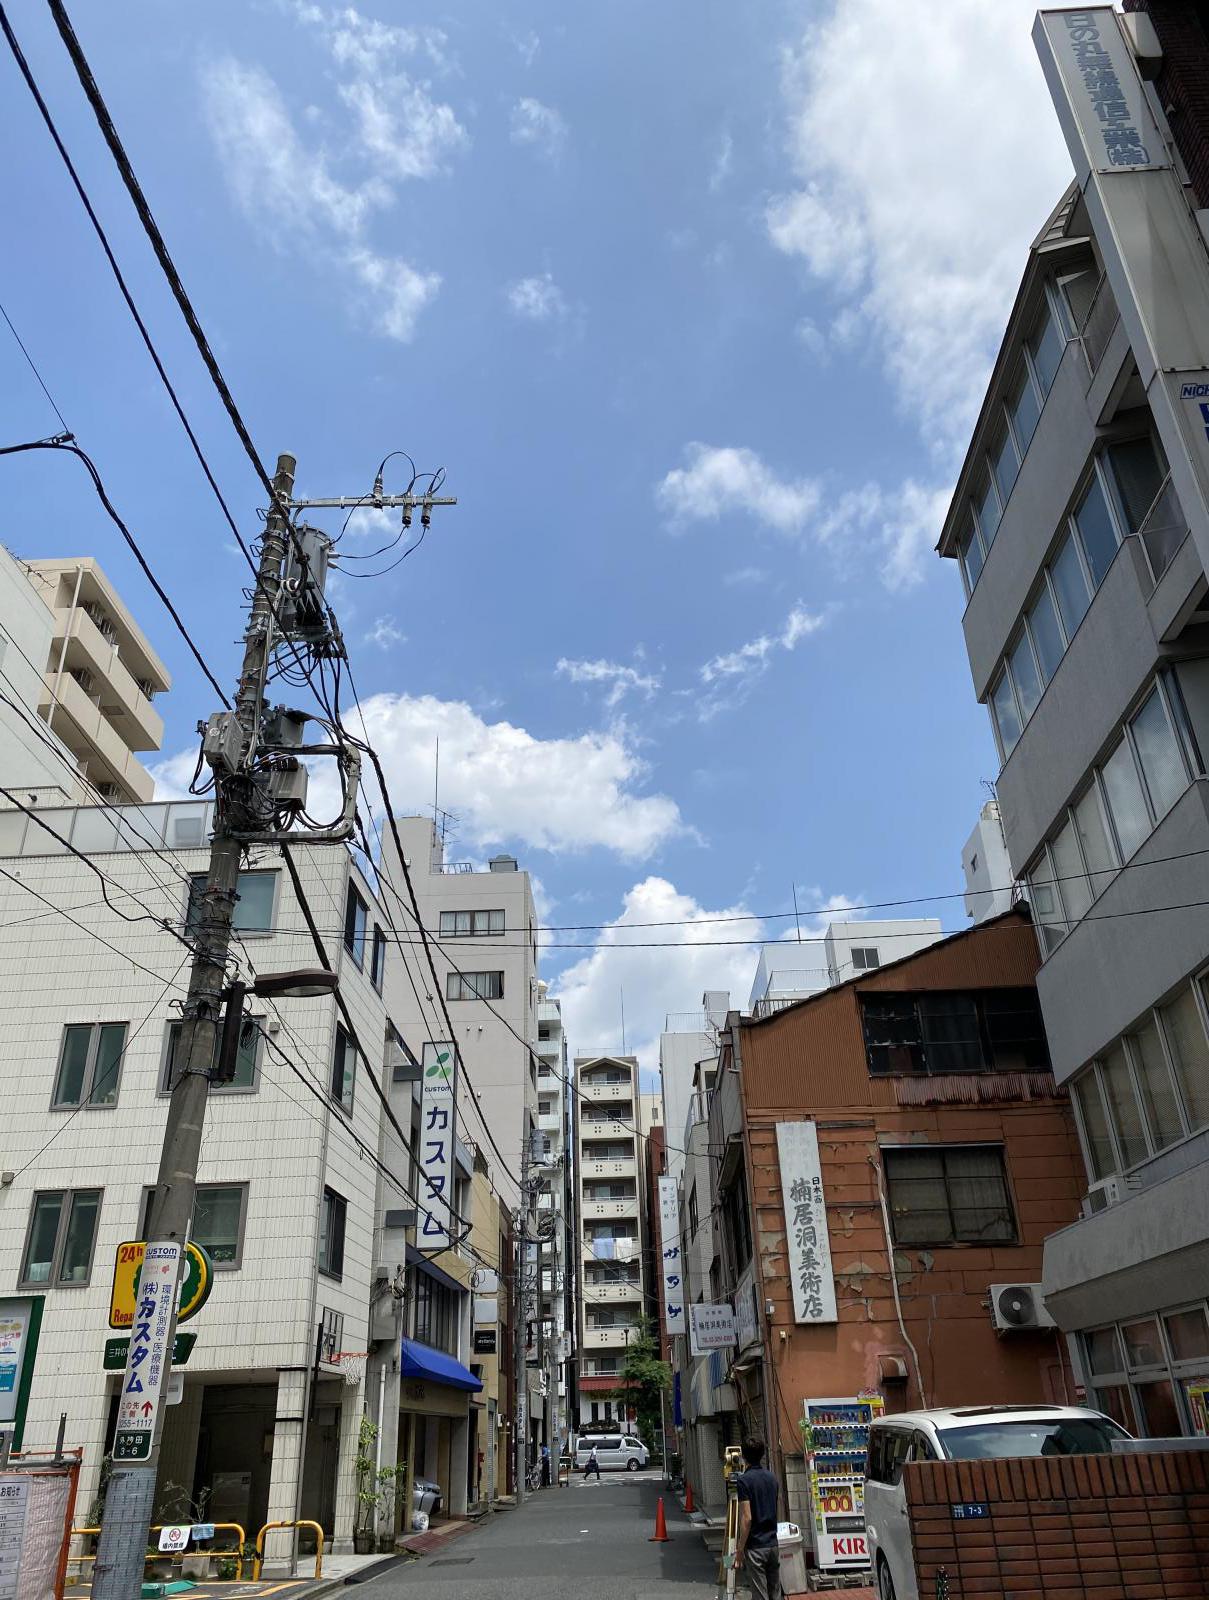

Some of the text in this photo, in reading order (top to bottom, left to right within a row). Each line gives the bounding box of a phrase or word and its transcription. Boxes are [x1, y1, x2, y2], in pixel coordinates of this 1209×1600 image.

[422, 1106, 449, 1235] カスタム
[113, 1309, 134, 1323] Repa
[833, 1538, 866, 1555] KIR
